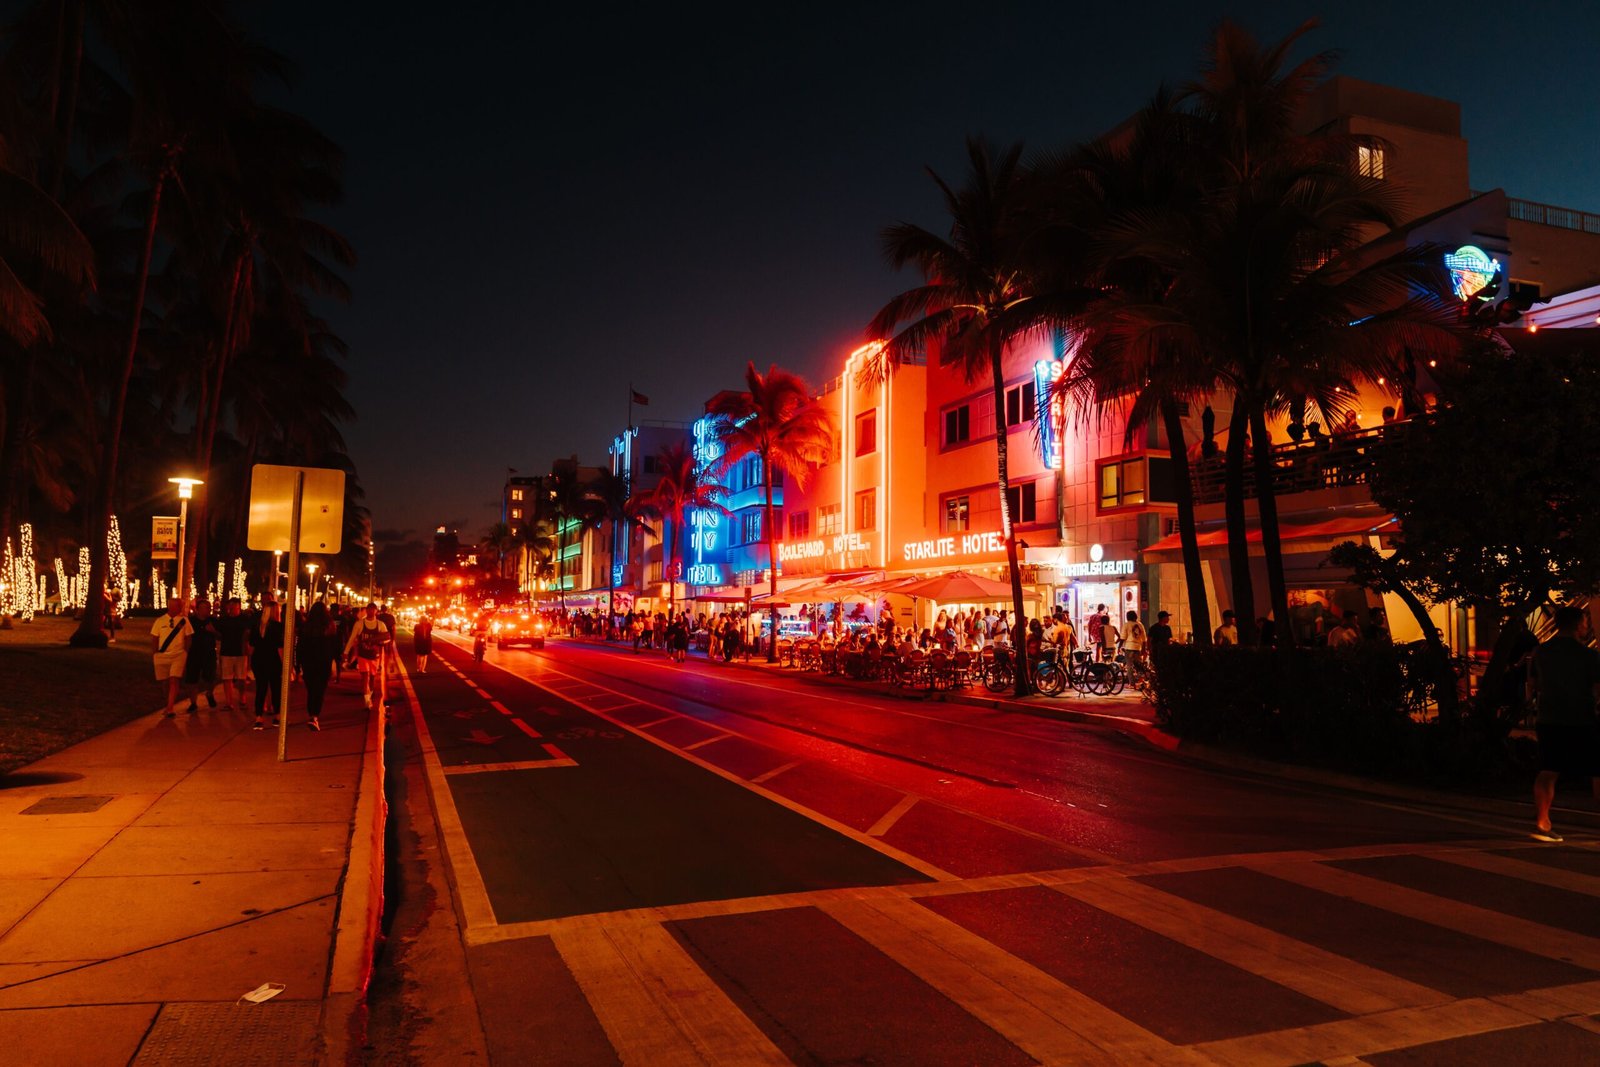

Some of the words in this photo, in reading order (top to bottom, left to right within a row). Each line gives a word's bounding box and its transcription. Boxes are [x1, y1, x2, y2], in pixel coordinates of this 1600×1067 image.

[1051, 360, 1063, 469] SARLITE
[778, 540, 825, 561] BOULEVARD
[833, 533, 866, 553] HOTEL
[904, 537, 955, 561] STARLITE
[962, 531, 1006, 554] HOTEL
[688, 564, 720, 585] TEL
[1102, 560, 1134, 575] GELATO
